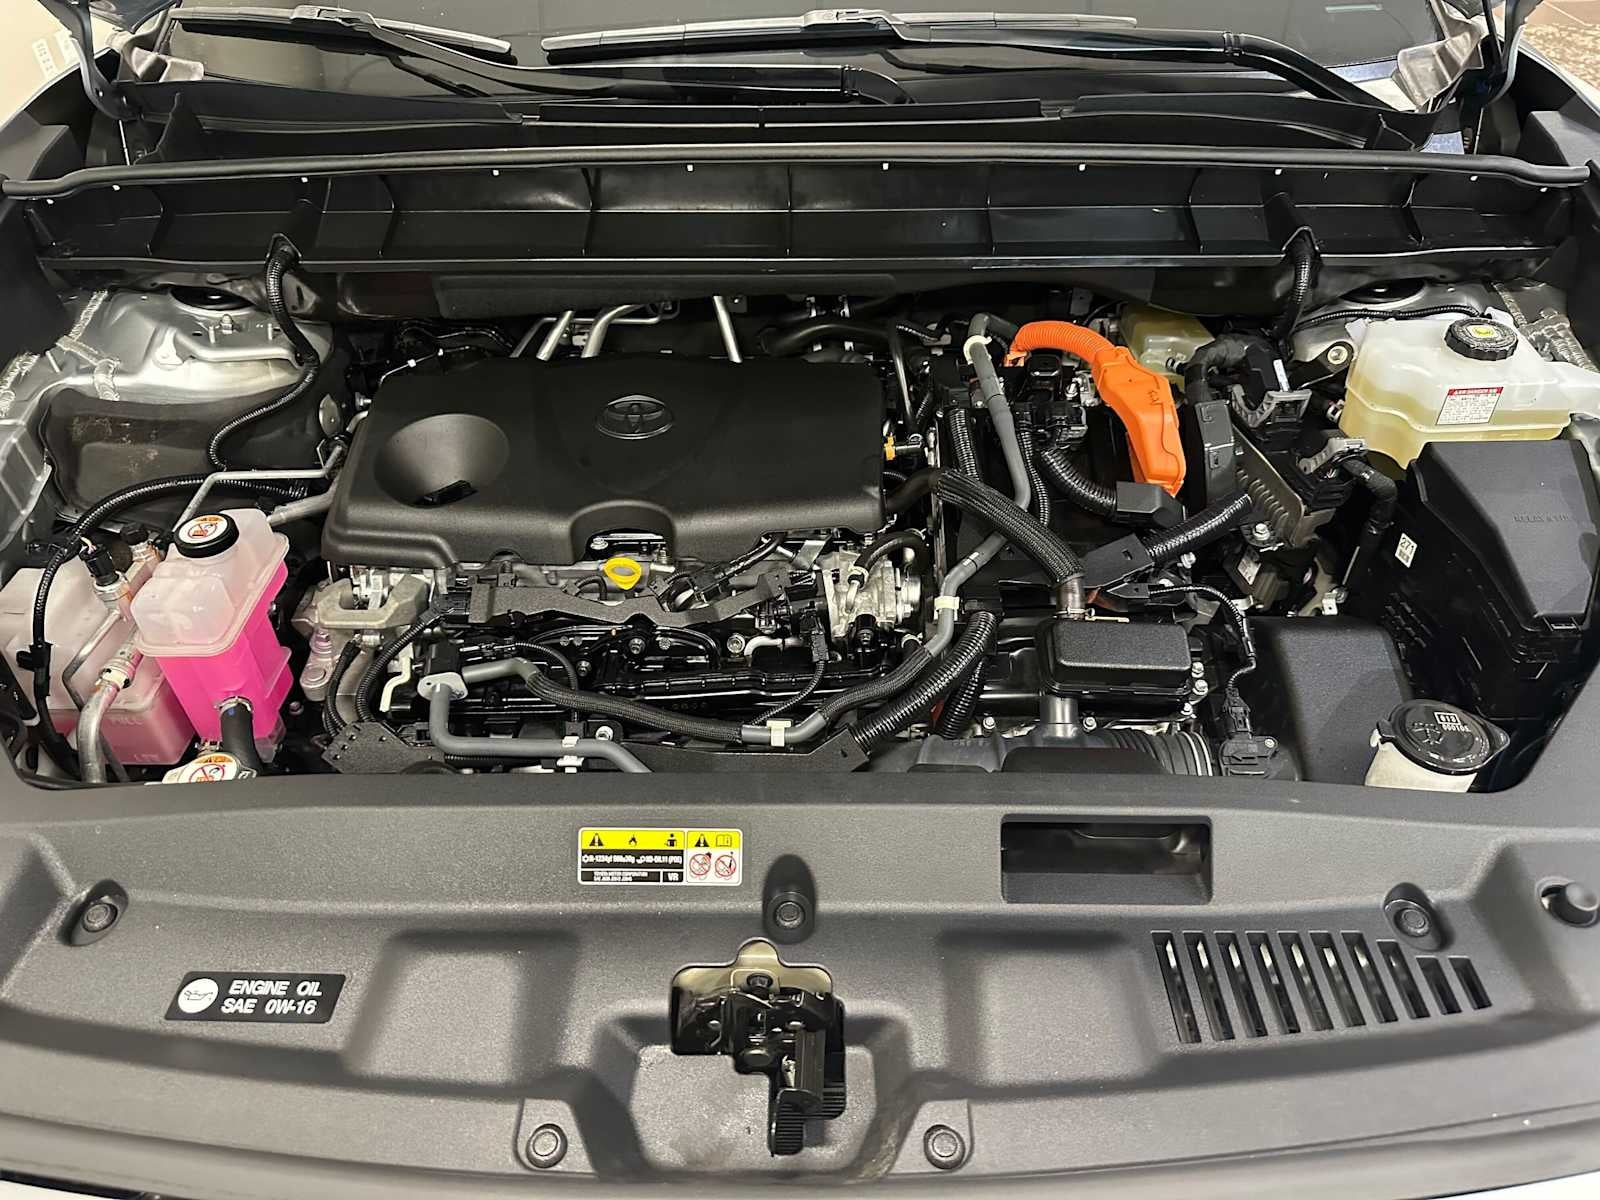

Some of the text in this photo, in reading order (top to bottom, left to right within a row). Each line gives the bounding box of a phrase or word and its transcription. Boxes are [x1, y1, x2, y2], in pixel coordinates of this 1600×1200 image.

[228, 980, 323, 997] ENGINE OIL
[221, 998, 318, 1015] SAE 0W-16
